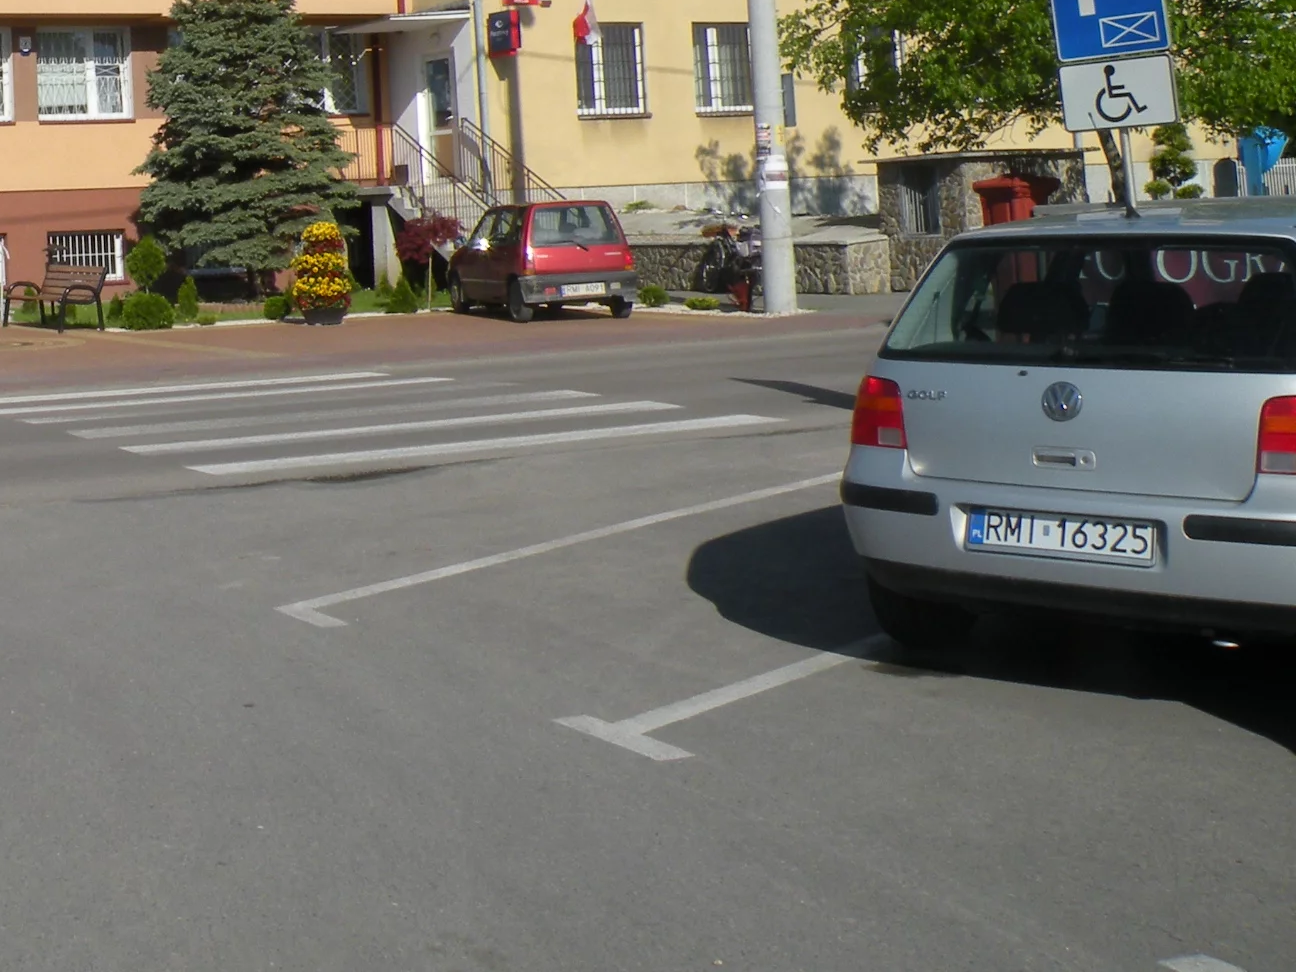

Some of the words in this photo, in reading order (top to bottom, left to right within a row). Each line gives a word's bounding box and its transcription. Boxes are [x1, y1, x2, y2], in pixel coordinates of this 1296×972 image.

[907, 389, 947, 401] GOLF
[985, 512, 1035, 544] RMI
[1057, 517, 1149, 555] 16325
